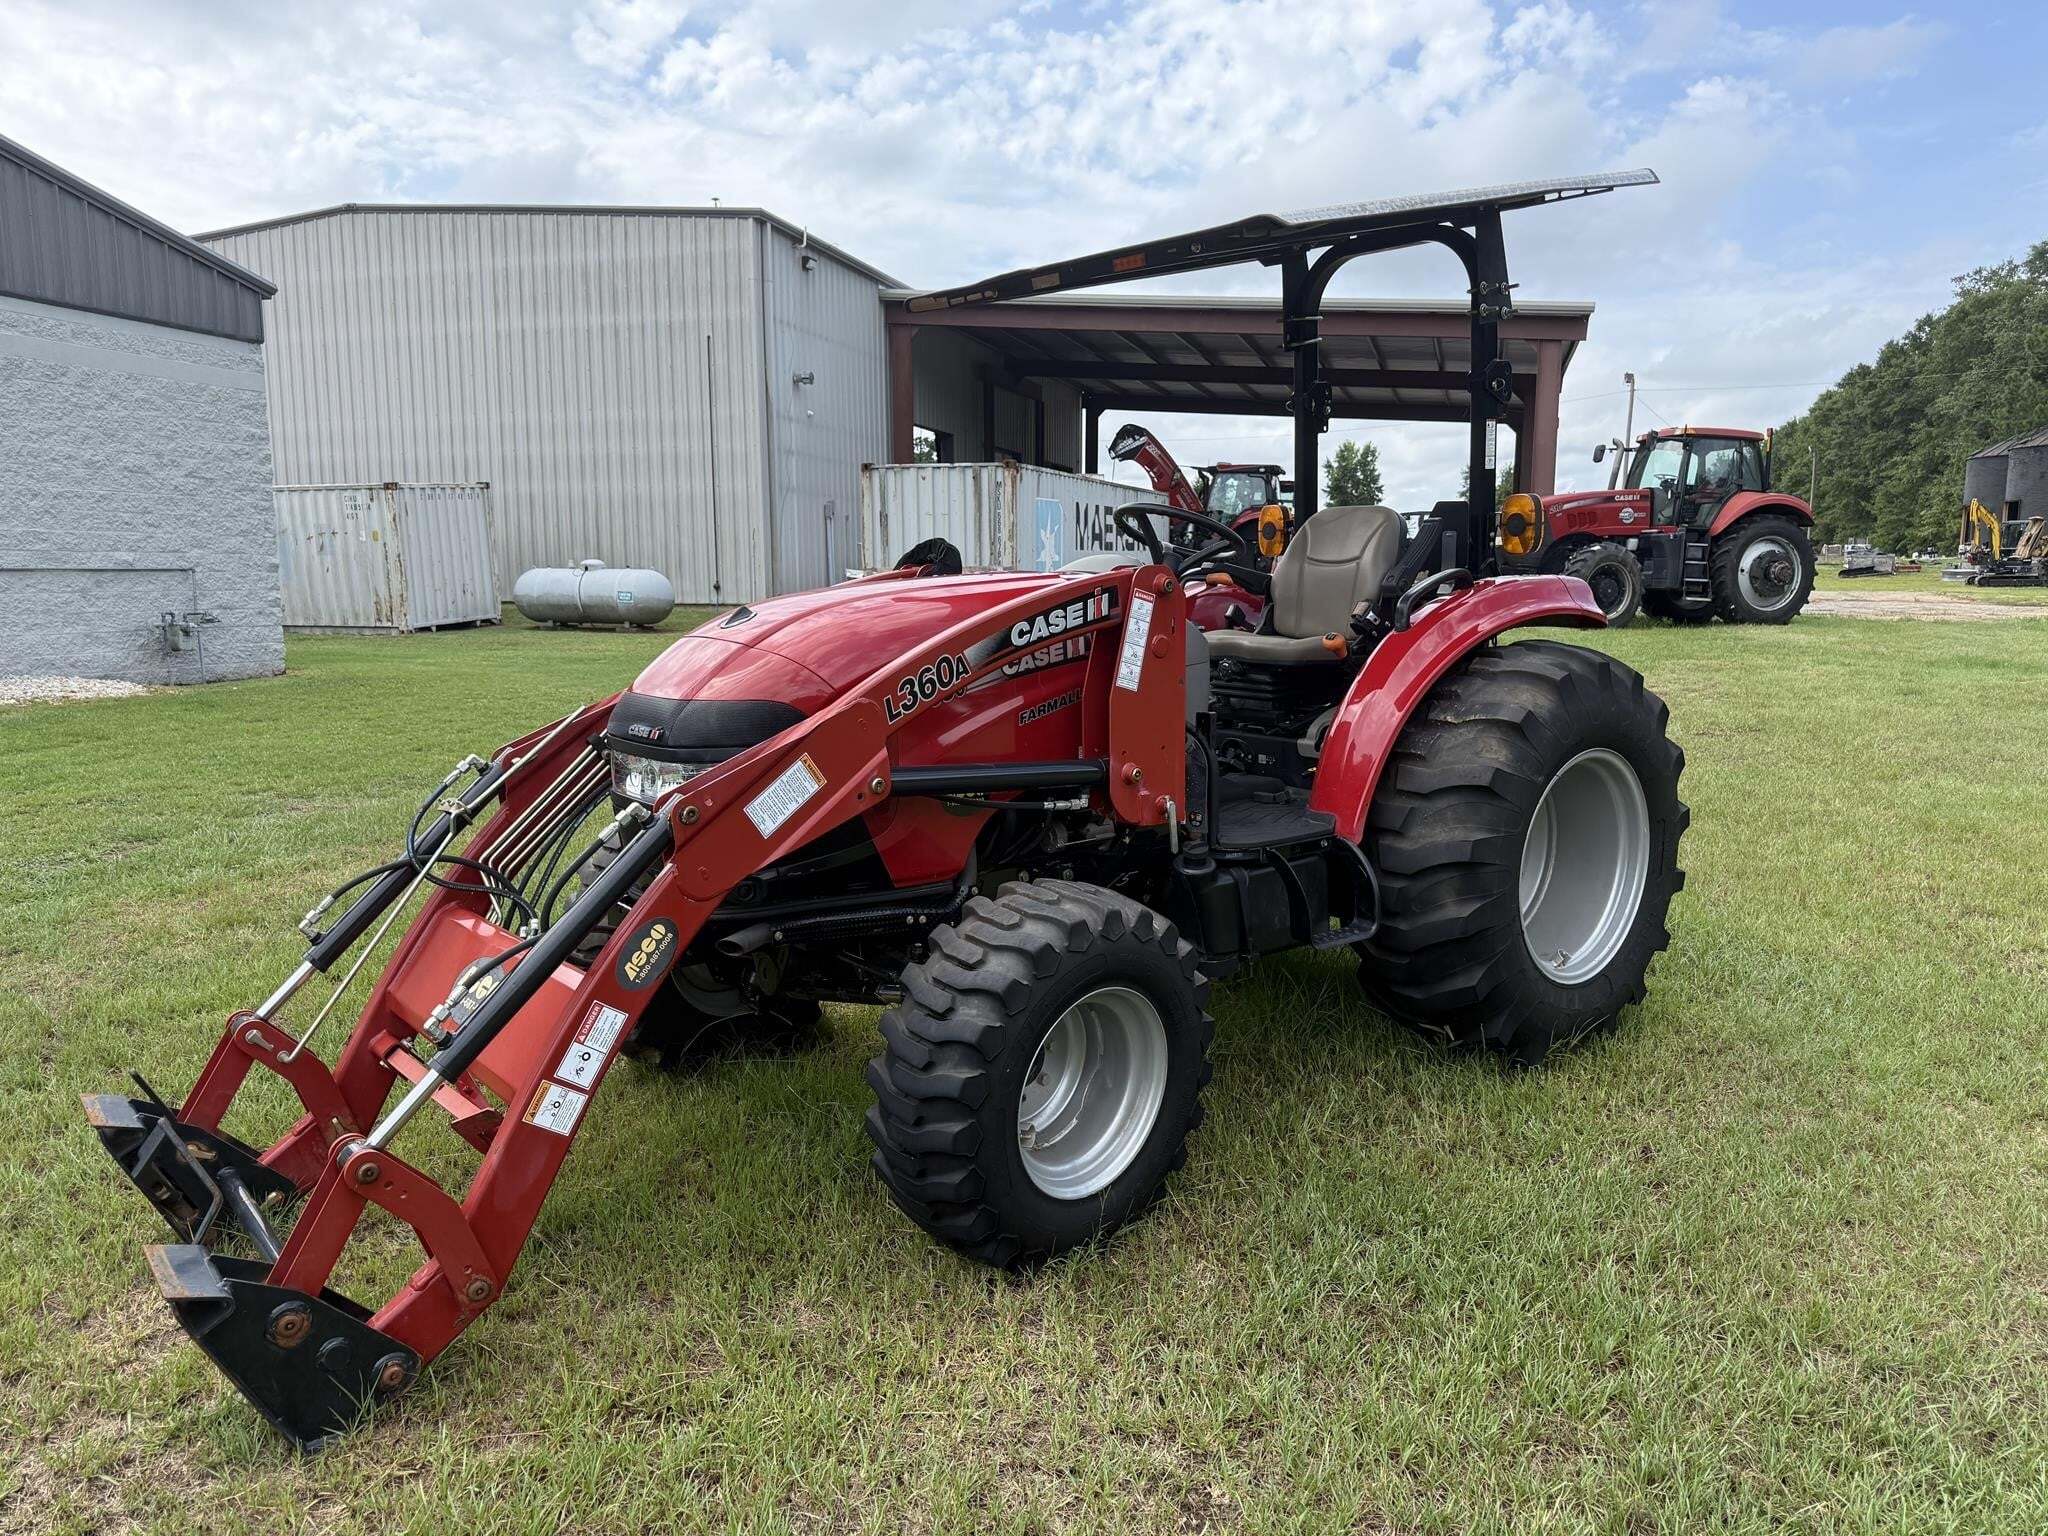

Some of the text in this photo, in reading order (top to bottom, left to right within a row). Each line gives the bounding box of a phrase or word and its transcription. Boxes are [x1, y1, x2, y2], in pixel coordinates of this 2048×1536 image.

[1010, 601, 1084, 647] CASE
[1001, 643, 1064, 677] CASE
[884, 654, 971, 726] L360A
[1018, 688, 1083, 727] FARMALL
[628, 724, 650, 738] CASE
[624, 923, 666, 984] ASCO
[580, 1004, 601, 1034] DANGER
